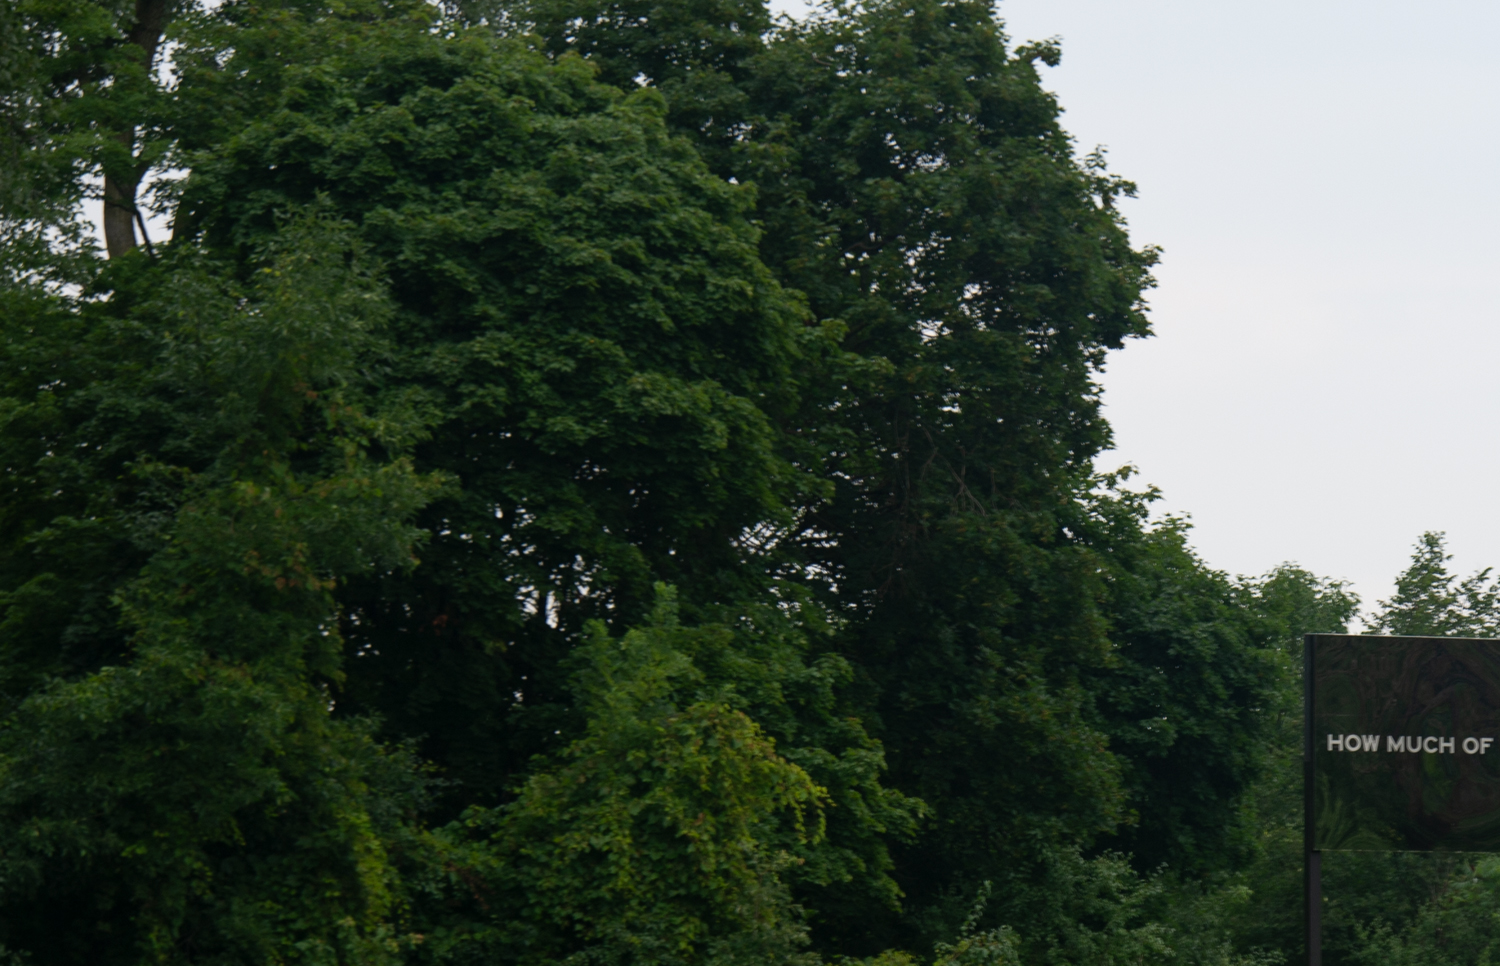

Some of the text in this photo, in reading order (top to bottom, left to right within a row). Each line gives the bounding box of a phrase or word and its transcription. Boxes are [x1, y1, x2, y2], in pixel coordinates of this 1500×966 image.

[1327, 734, 1380, 752] HOW
[1387, 735, 1455, 754] MUCH
[1462, 737, 1494, 755] OF
